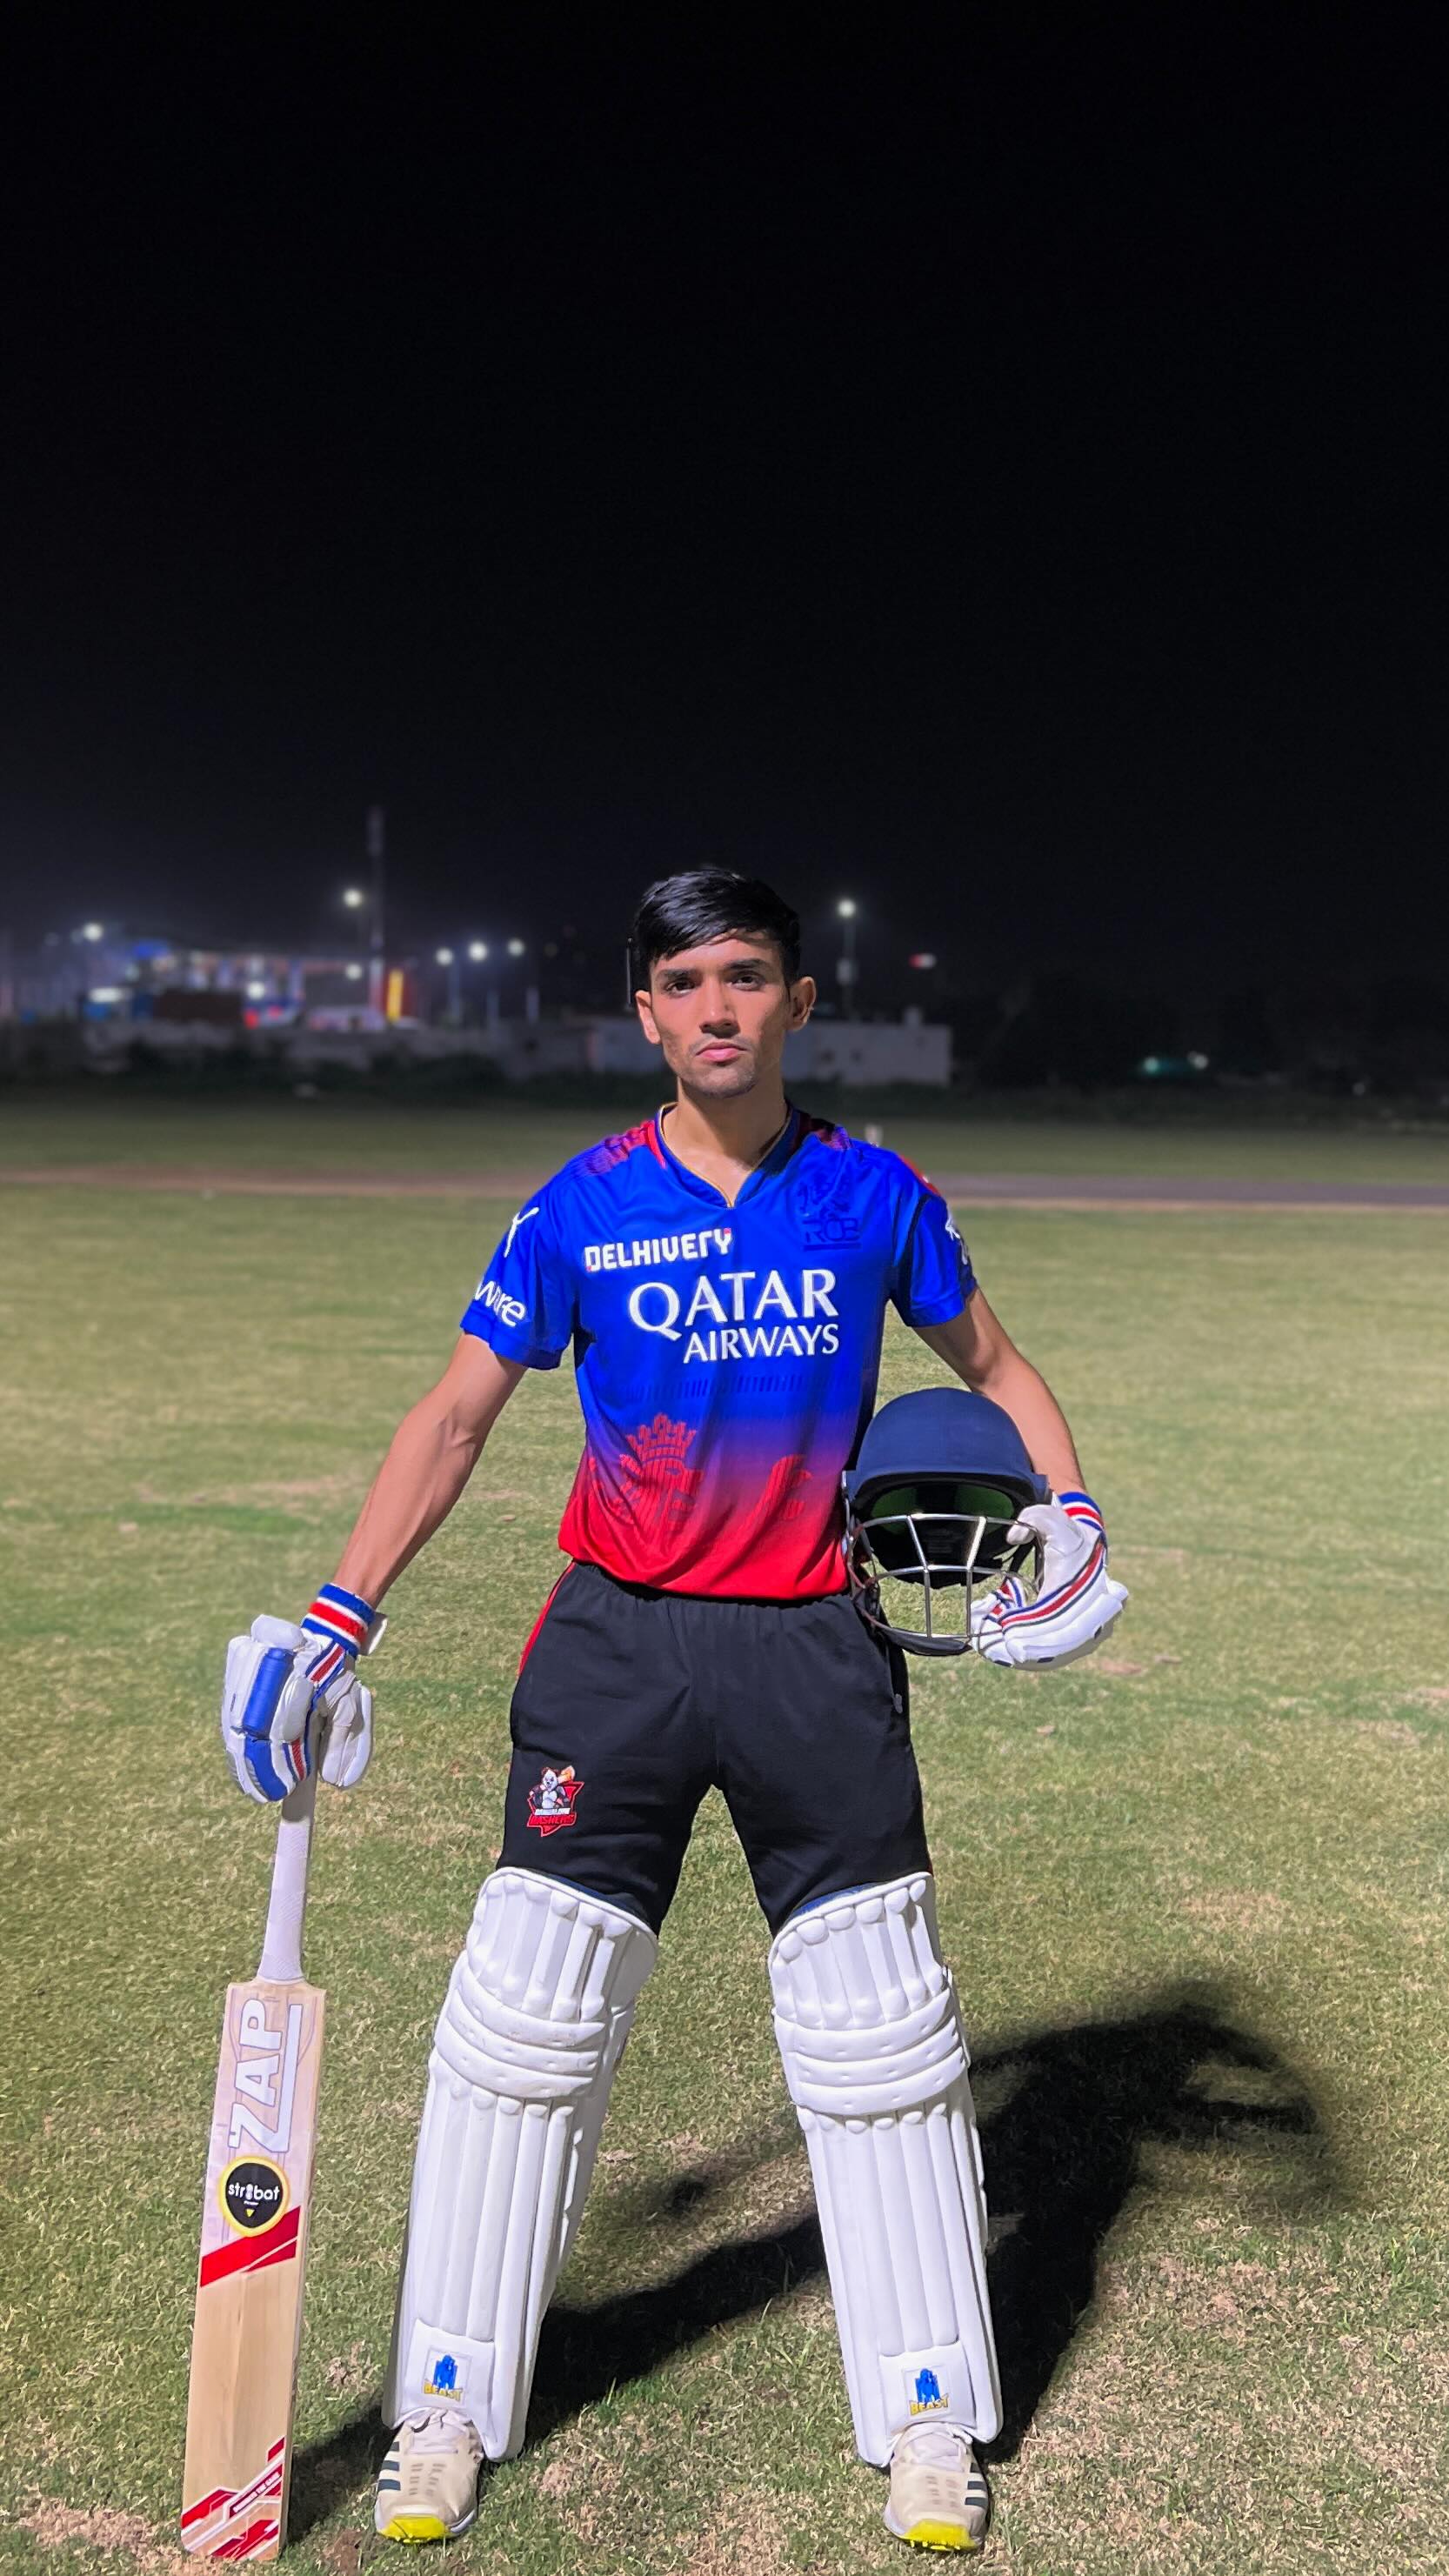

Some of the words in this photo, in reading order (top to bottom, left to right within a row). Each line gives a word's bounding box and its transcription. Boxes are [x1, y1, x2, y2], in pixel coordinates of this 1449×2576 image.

[584, 1227, 732, 1272] DELHIVERY
[629, 1269, 839, 1341] QATAR
[683, 1324, 839, 1364] AIRWAYS
[228, 1999, 303, 2153] ZAP
[909, 2393, 950, 2416] BEAST
